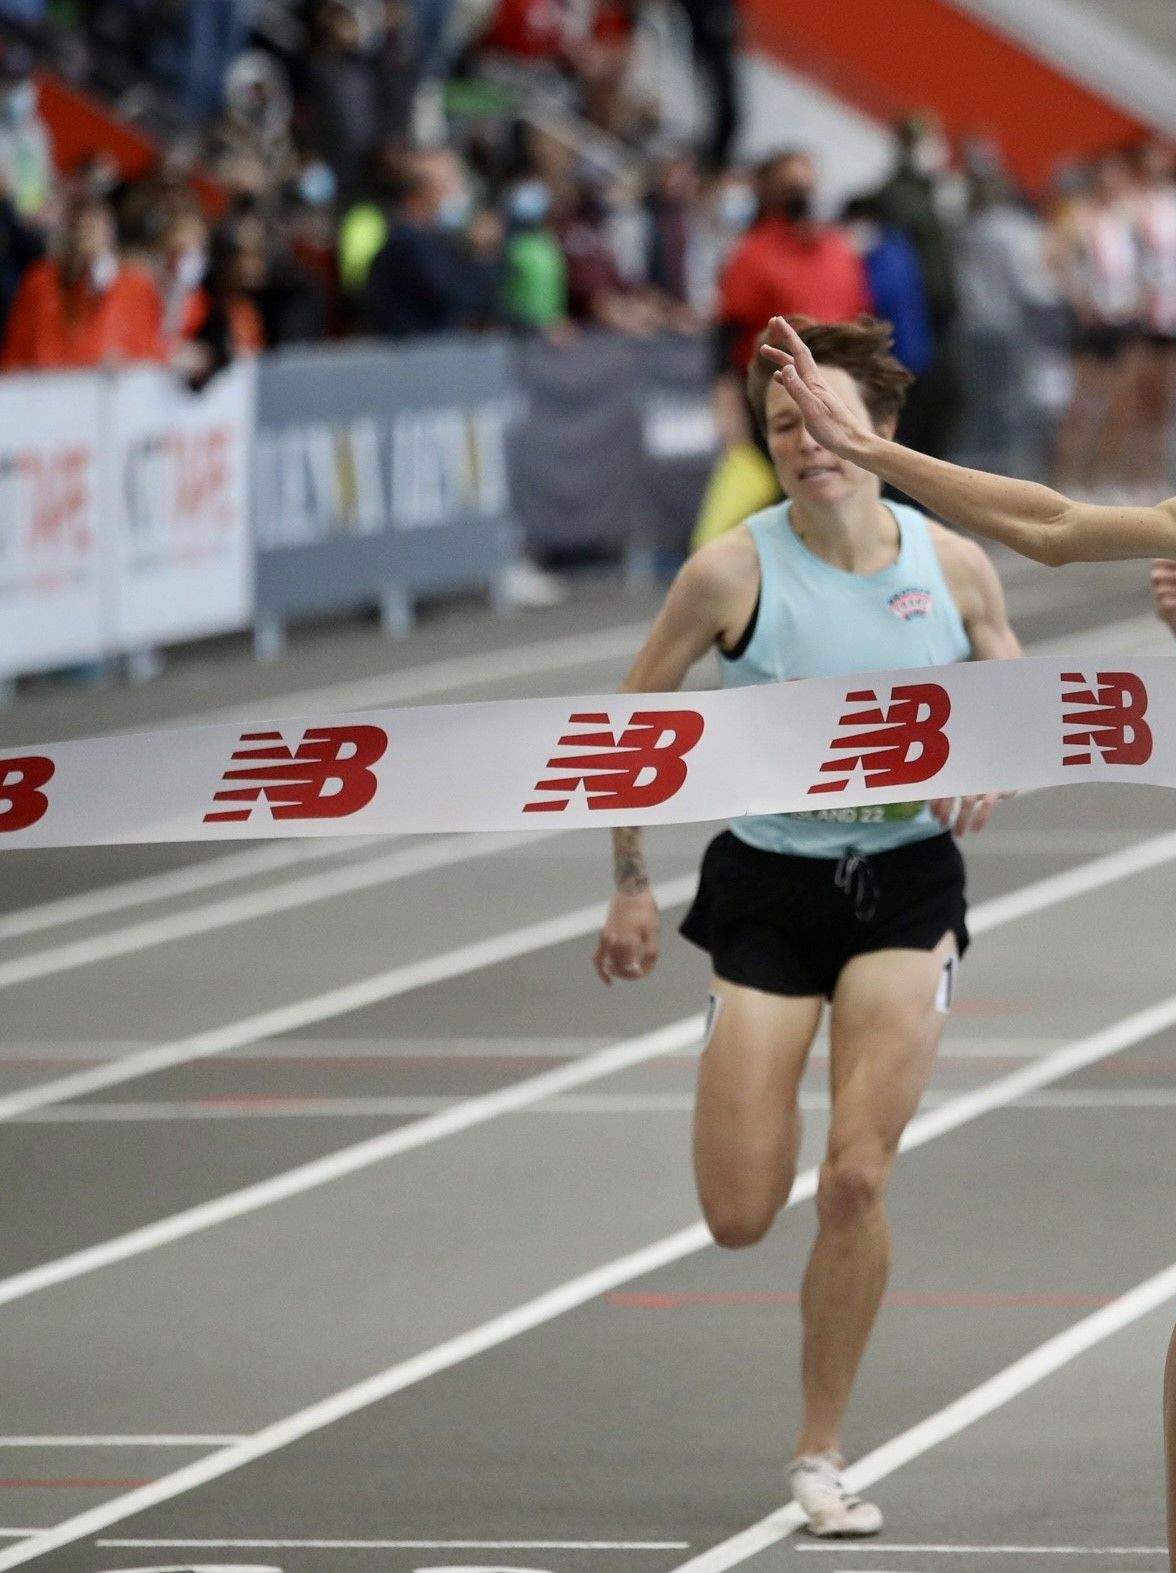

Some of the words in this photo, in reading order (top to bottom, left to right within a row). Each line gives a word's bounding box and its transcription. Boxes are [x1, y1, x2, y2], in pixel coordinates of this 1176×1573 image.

[0, 756, 56, 833] B
[203, 725, 389, 823] NB
[522, 710, 704, 812] NB
[806, 683, 952, 795] NB
